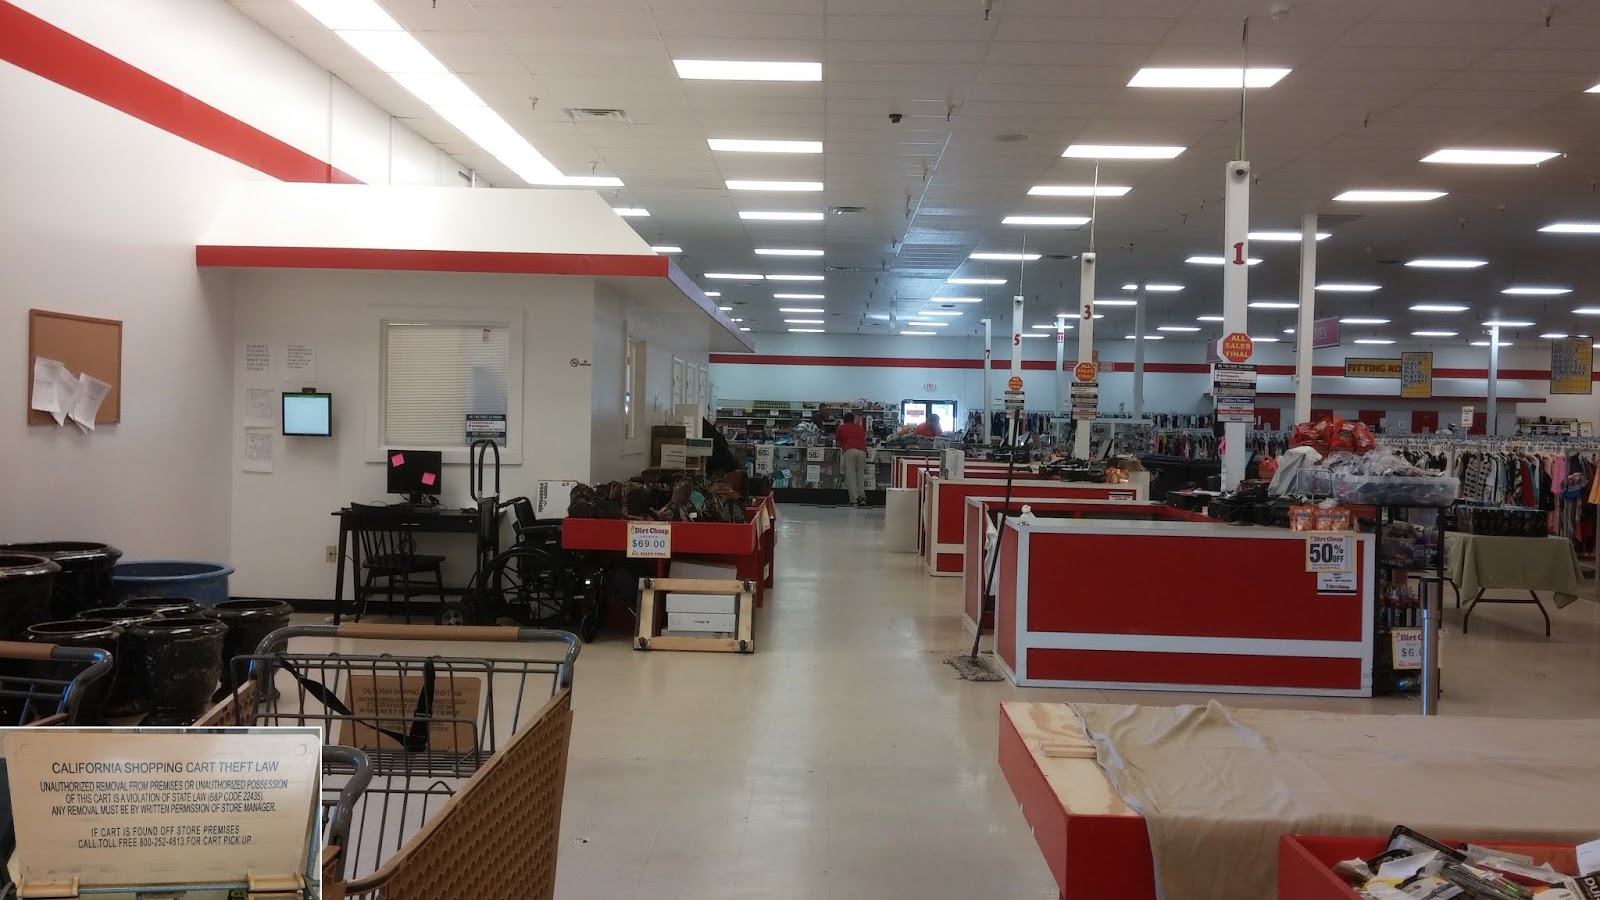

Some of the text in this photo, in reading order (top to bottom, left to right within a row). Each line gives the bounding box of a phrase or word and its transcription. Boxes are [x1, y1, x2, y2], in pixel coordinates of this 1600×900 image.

[1233, 242, 1244, 265] 1
[1084, 304, 1092, 320] 3
[1014, 334, 1020, 346] 5
[986, 350, 990, 360] 7
[1348, 364, 1402, 372] FITTING RO
[632, 539, 665, 548] $69.00
[1402, 648, 1422, 657] $6.
[52, 761, 279, 774] CALIFORNIA SHOPPING CART THEFT LAW
[40, 779, 288, 792] UNAUTHORIZED REMOVAL FROM PREMISES OR UNAUTHORIZED POSSESSION
[66, 794, 75, 803] OF
[77, 794, 92, 803] THIS
[94, 794, 111, 803] CART
[113, 794, 119, 803] IS
[121, 794, 125, 803] A
[126, 793, 160, 802] VIOLATION
[162, 793, 170, 802] OF
[172, 793, 191, 802] STATE
[193, 792, 206, 802] LAW
[224, 792, 242, 801] CODE
[52, 806, 66, 815] ANY
[68, 805, 99, 815] REMOVAL
[101, 805, 119, 814] MUST
[121, 805, 129, 814] BE
[131, 805, 139, 814] BY
[141, 804, 169, 814] WRITTEN
[171, 804, 210, 813] PERMISSION
[211, 803, 220, 812] OF
[221, 803, 243, 812] STORE
[91, 825, 240, 837] IF CART IS FOUND OFF STORE PREMISES
[78, 836, 251, 848] CALL TOLL FREE 800-252-4613 FOR CART PICK UP
